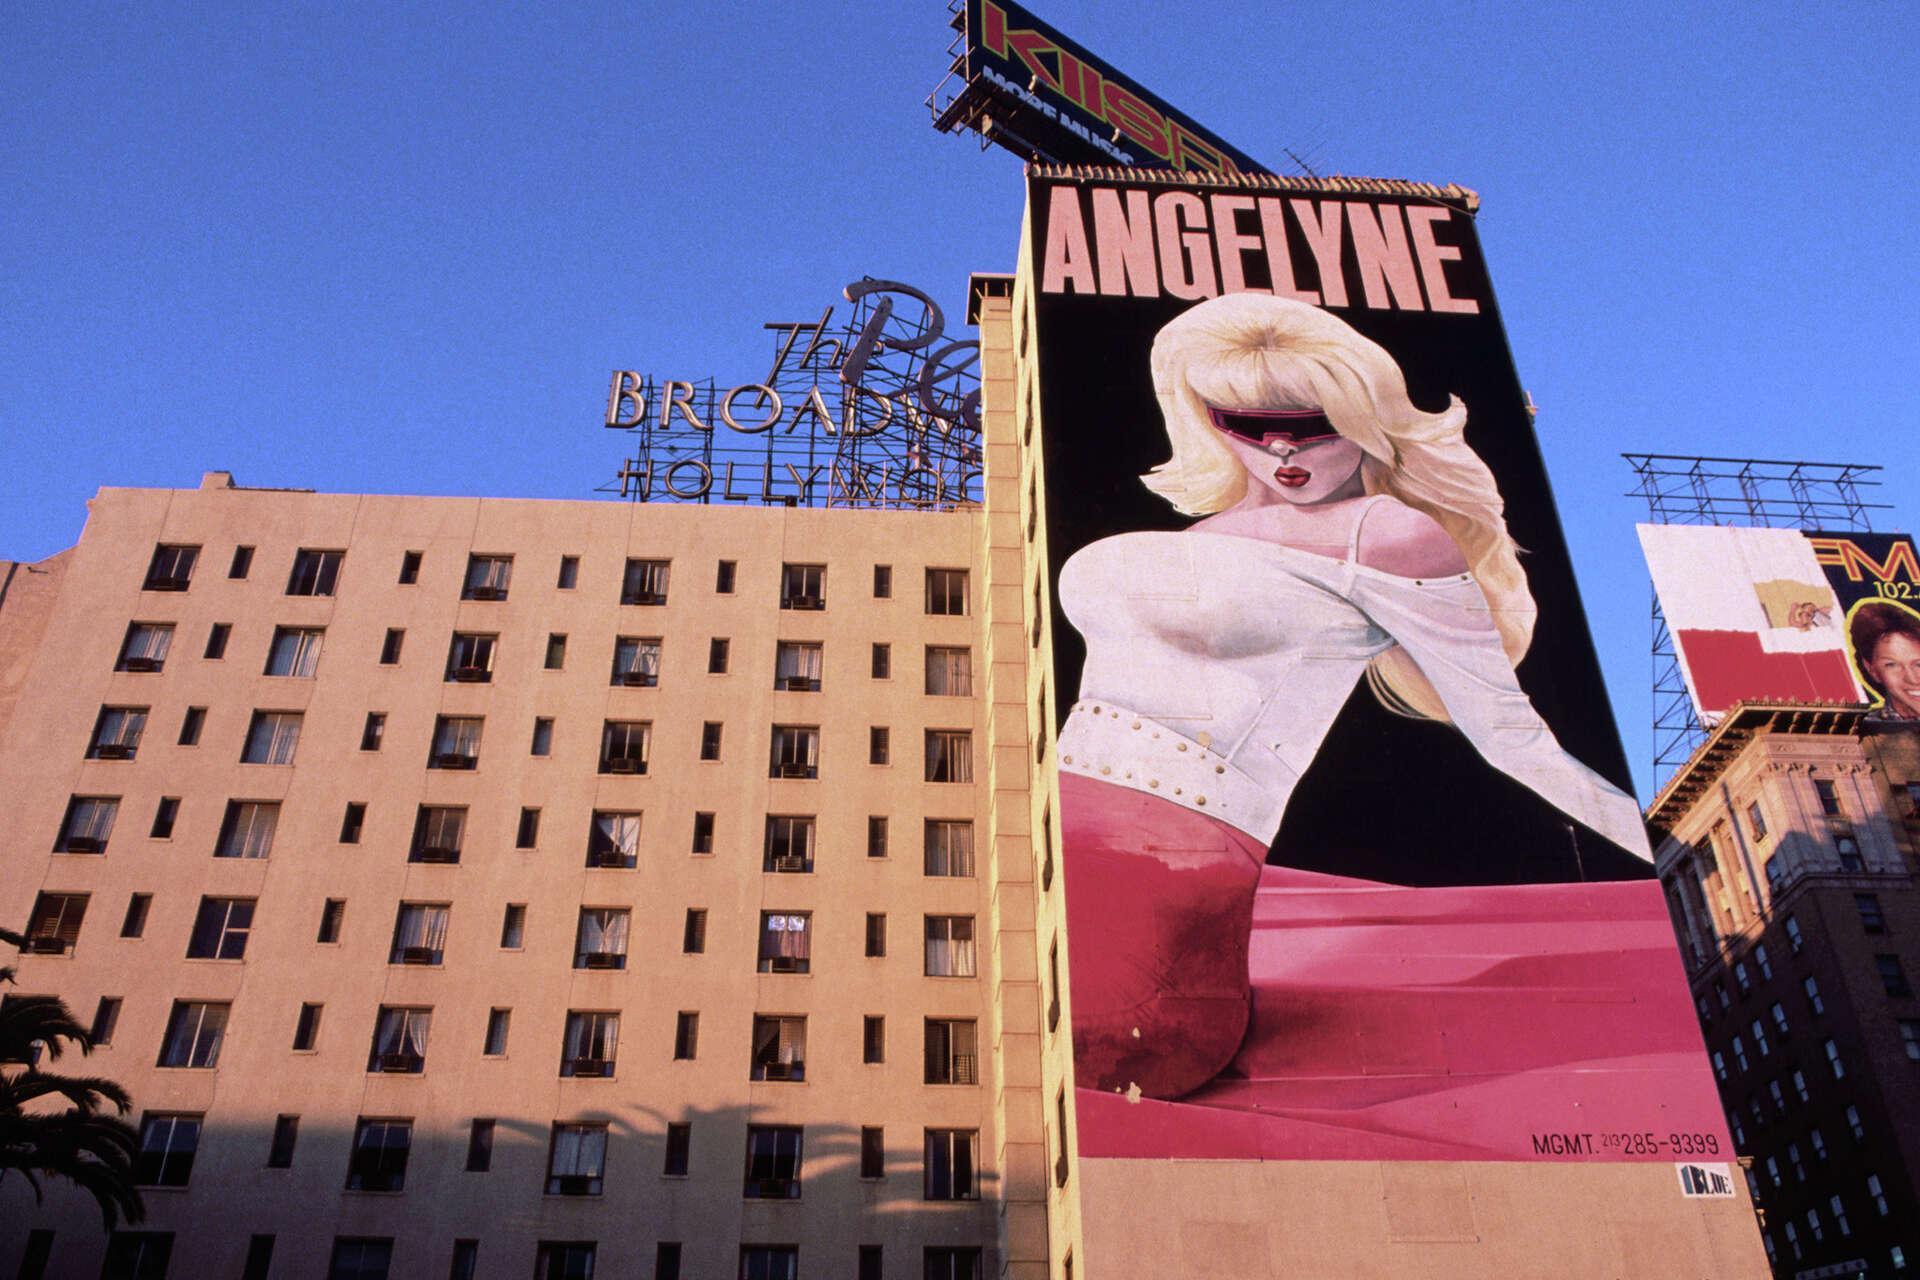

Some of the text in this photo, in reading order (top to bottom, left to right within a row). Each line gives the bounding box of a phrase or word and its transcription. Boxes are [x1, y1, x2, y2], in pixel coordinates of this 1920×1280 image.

[1042, 184, 1481, 315] ANGELYNE
[1873, 581, 1920, 600] 102.
[1531, 1133, 1600, 1155] MGMT.
